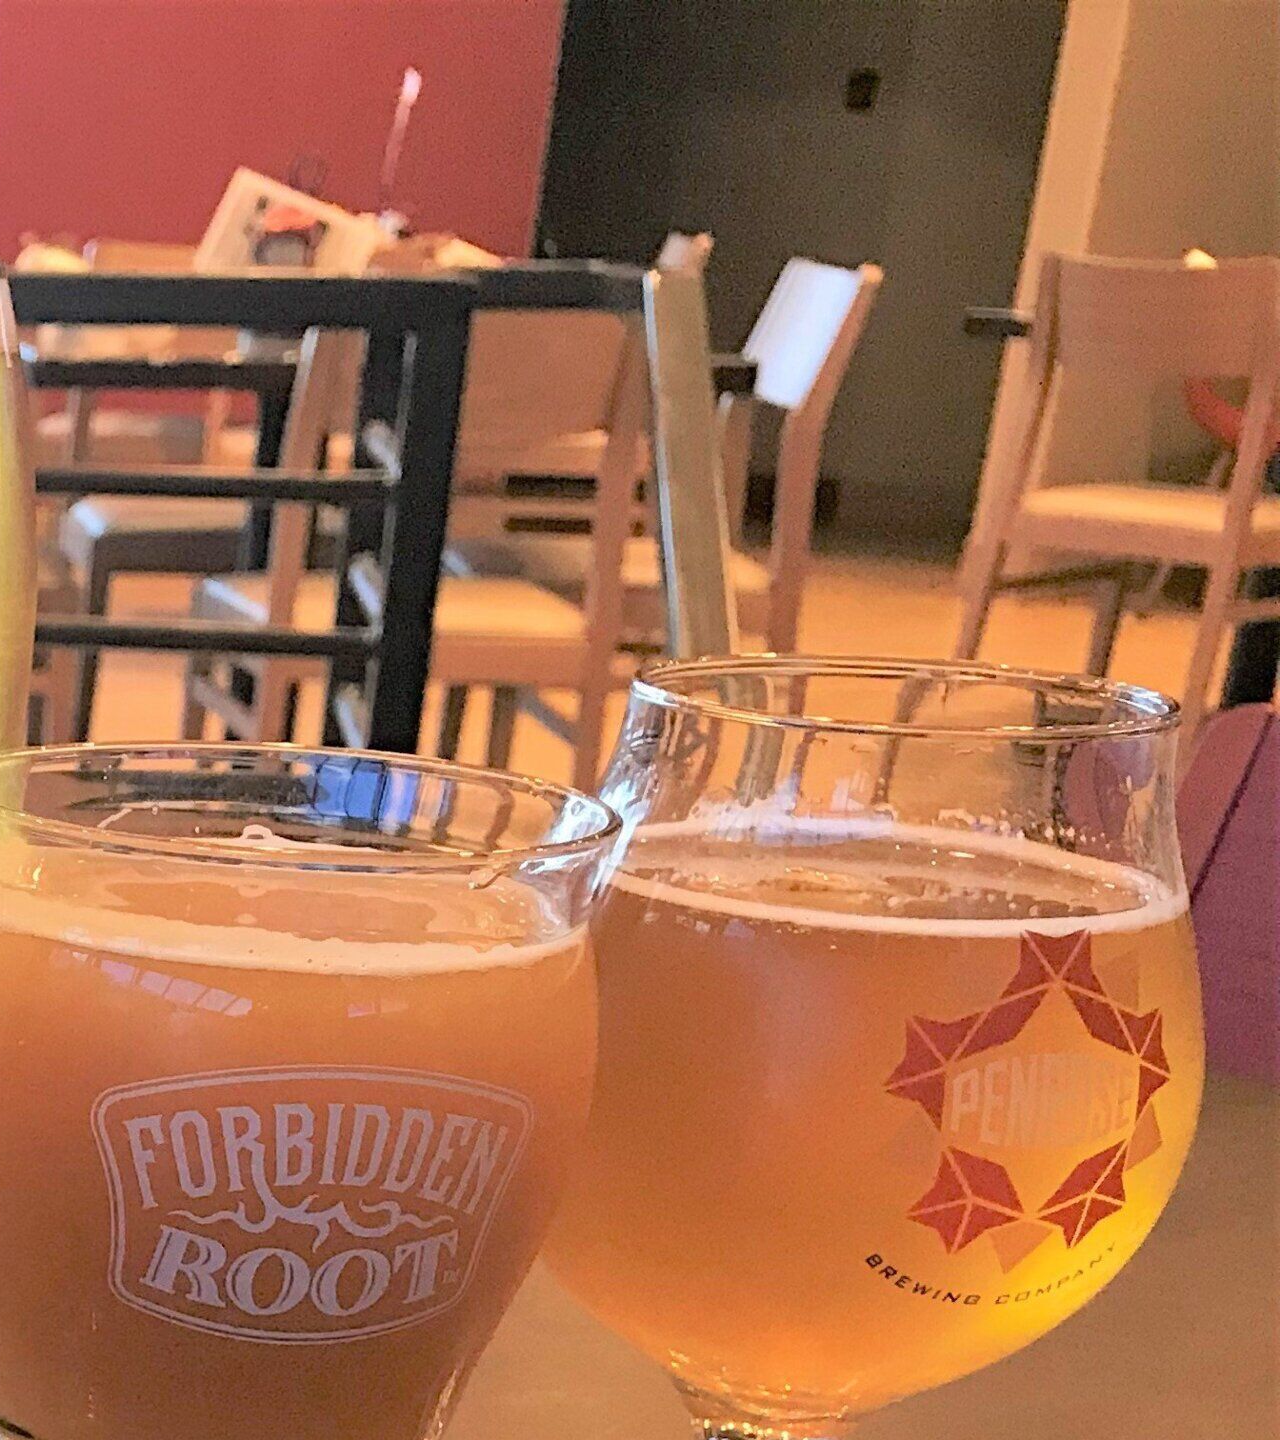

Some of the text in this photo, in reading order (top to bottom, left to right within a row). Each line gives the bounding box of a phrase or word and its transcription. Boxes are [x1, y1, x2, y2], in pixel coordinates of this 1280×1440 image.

[122, 1103, 508, 1216] FORBIDDEN
[140, 1223, 459, 1317] ROOT
[864, 1241, 1116, 1306] BREWING COMPANY
